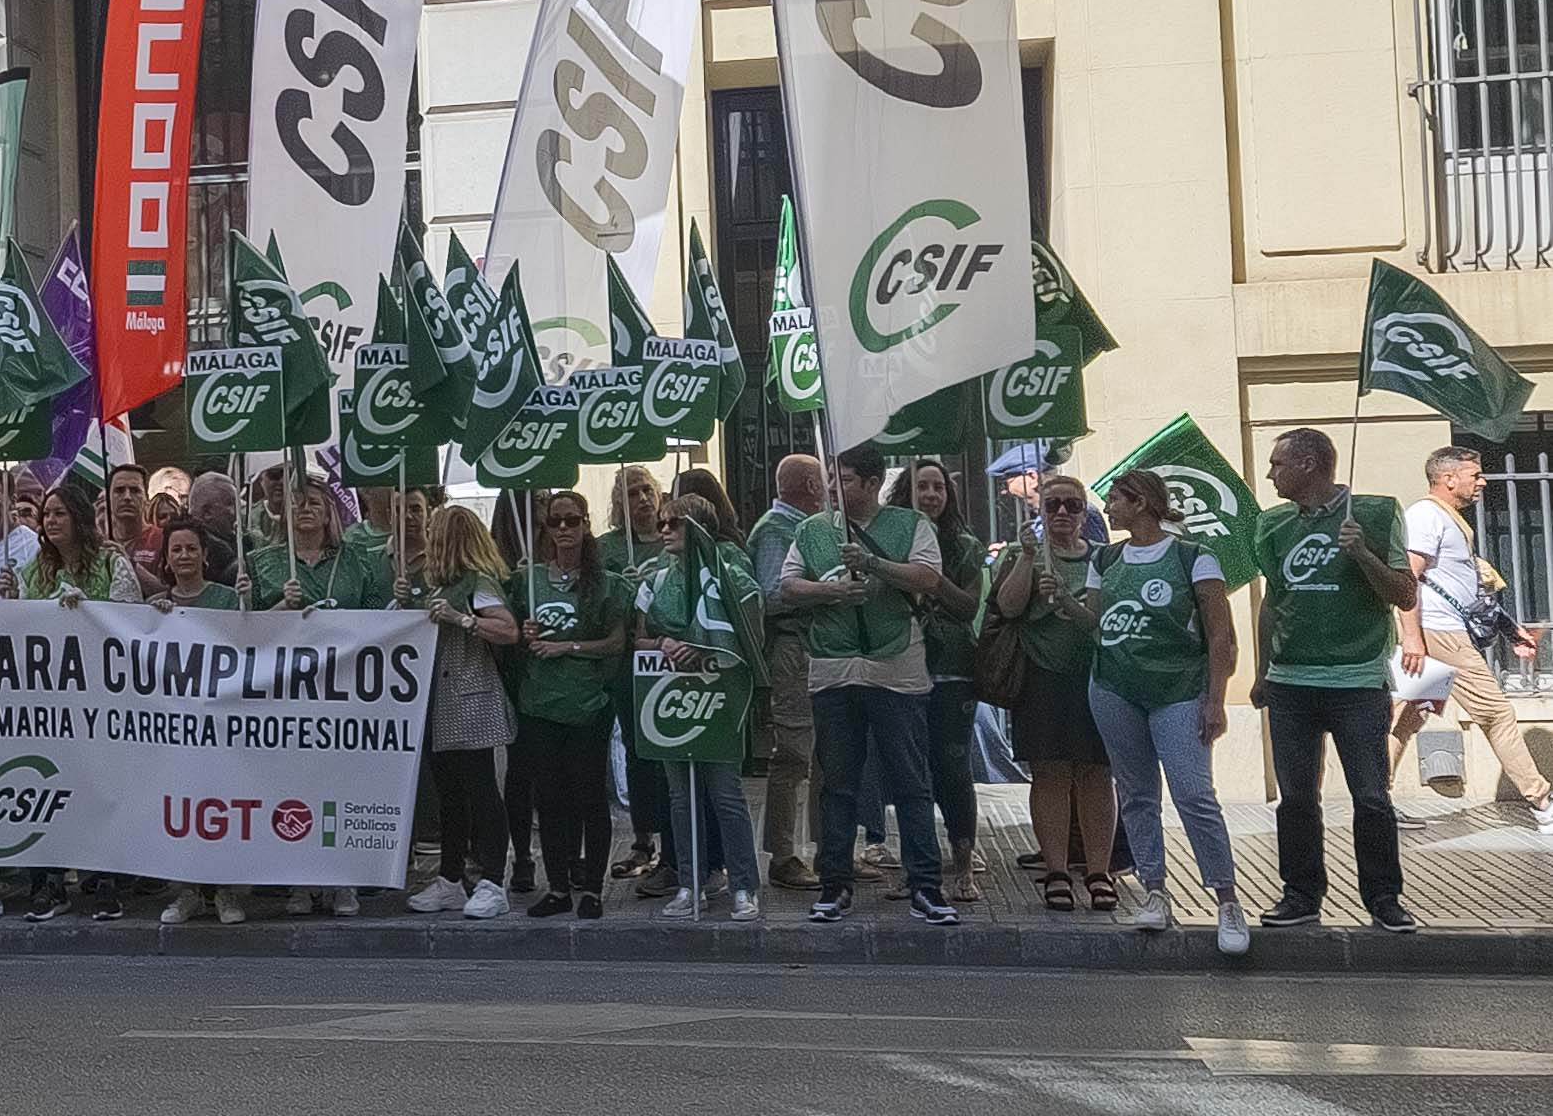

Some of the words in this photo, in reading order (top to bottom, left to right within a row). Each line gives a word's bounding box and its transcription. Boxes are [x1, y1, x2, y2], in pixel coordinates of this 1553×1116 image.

[877, 244, 1004, 305] CSIF
[126, 311, 167, 335] Málaga
[308, 316, 364, 363] SIF
[646, 340, 717, 362] MÁLAGA
[1386, 325, 1479, 380] CSIF
[190, 350, 278, 372] MÁLAGA
[570, 367, 642, 390] MÁLAG
[656, 372, 710, 403] CSIF
[1006, 365, 1072, 397] CSIF
[206, 385, 270, 415] CSIF
[498, 421, 567, 451] CSIF
[102, 637, 420, 704] CUMPLIRLOS
[658, 688, 727, 720] CSIF
[83, 707, 99, 740] Y
[107, 709, 218, 747] CARRERA
[227, 715, 416, 752] PROFESIONAL
[163, 794, 263, 842] UGT
[344, 802, 401, 816] Servicios
[344, 817, 397, 832] Públicos
